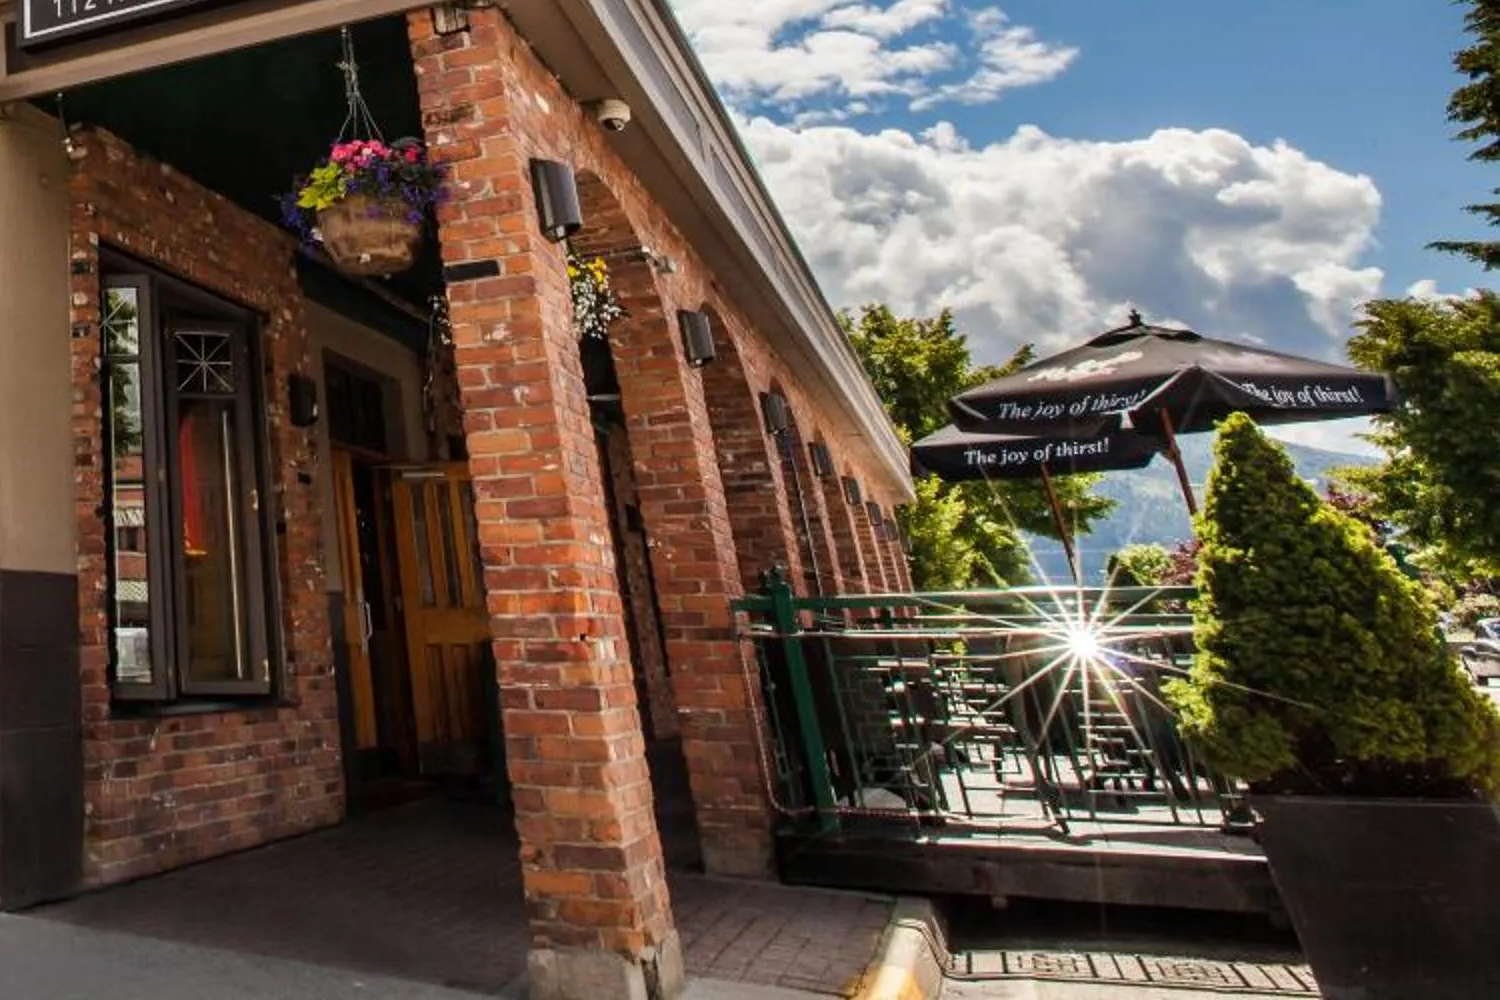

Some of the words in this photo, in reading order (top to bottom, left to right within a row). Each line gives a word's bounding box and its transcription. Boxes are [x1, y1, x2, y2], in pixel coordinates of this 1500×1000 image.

[999, 402, 1033, 420] The
[1030, 400, 1066, 421] joy
[1069, 395, 1091, 417] of
[1271, 385, 1298, 408] joy
[1297, 384, 1319, 407] of
[963, 450, 998, 466] The
[1000, 447, 1030, 466] joy
[1033, 443, 1054, 463] of
[1055, 437, 1110, 458] thirst!
